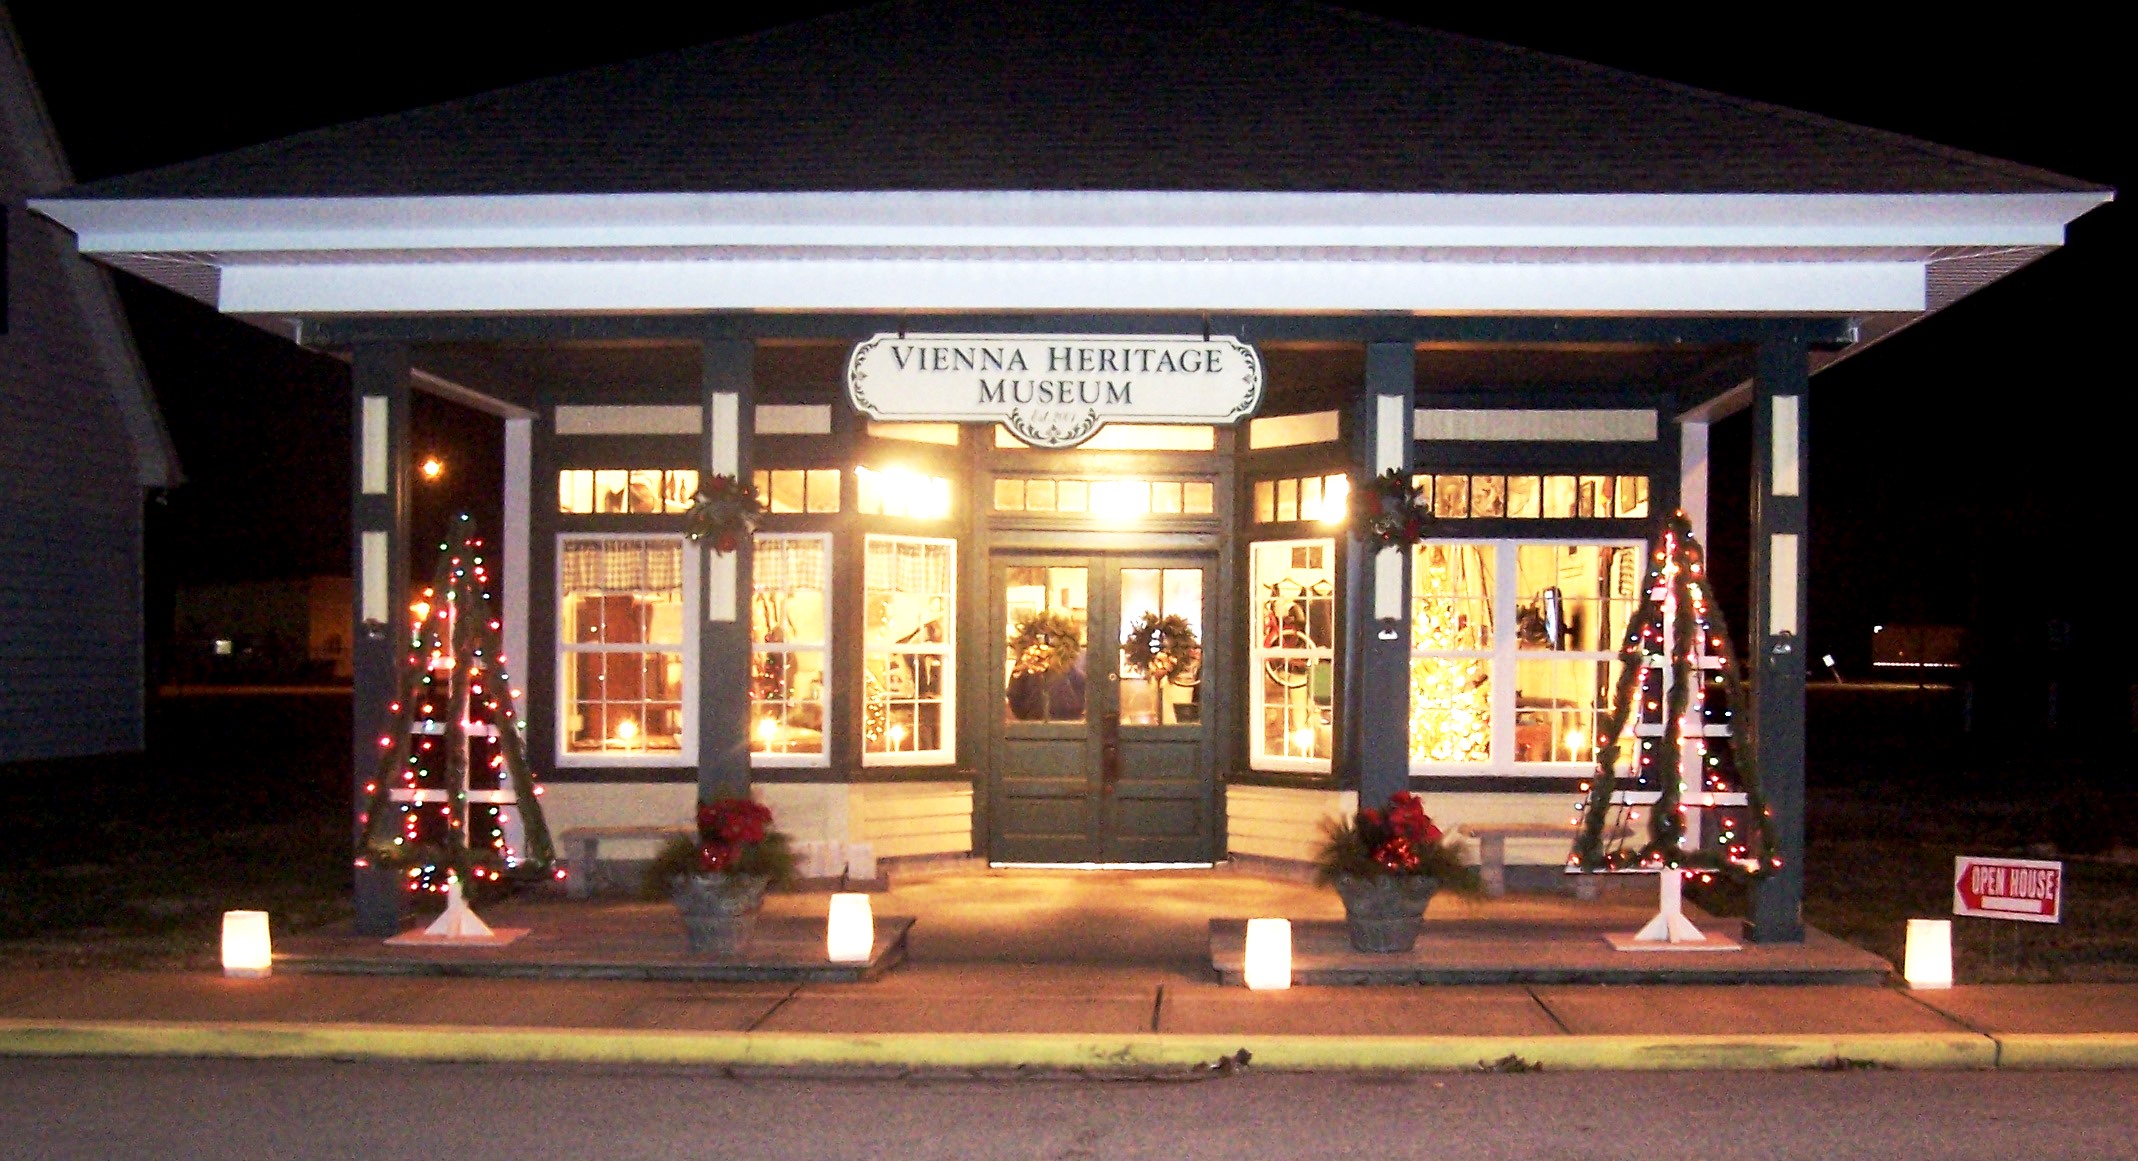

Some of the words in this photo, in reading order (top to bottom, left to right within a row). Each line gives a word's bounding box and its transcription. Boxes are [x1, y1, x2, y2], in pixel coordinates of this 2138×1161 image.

[891, 346, 1028, 372] VIENNA
[1048, 347, 1223, 374] HERITAGE
[978, 380, 1133, 405] MUSEUM
[1972, 865, 2004, 896] OPEN
[2010, 867, 2054, 899] HOUSE
